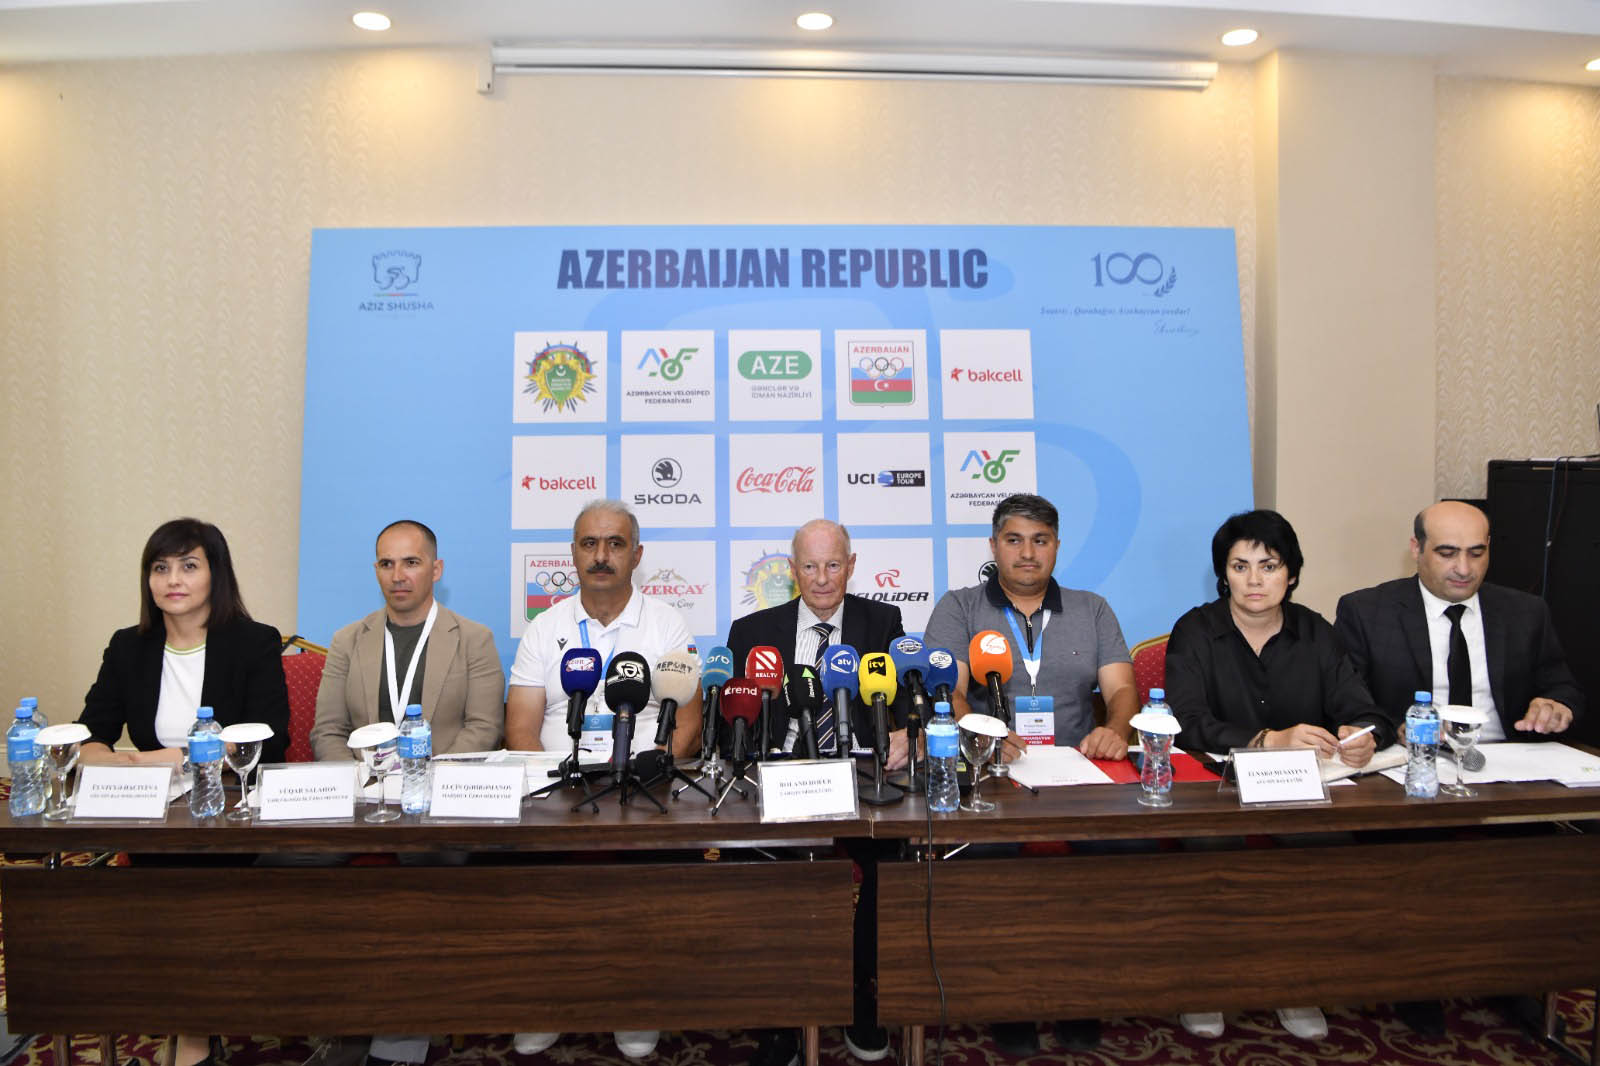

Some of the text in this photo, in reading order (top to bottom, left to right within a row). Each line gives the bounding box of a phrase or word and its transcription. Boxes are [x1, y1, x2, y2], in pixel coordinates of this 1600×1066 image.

[557, 246, 989, 289] AZERBAIJAN REPUBLIC
[358, 301, 435, 312] AZIZ SHUSHA
[853, 345, 910, 354] AZERBAIJAN
[751, 355, 799, 375] AZE
[968, 368, 1024, 382] bakcell
[539, 476, 597, 491] bakcell
[736, 466, 817, 494] Coca-Cola
[848, 473, 875, 485] UCI
[640, 584, 706, 598] ZERÇAY
[656, 660, 694, 674] REPORT
[837, 658, 852, 666] atv
[868, 660, 885, 669] itv
[723, 685, 758, 697] trend
